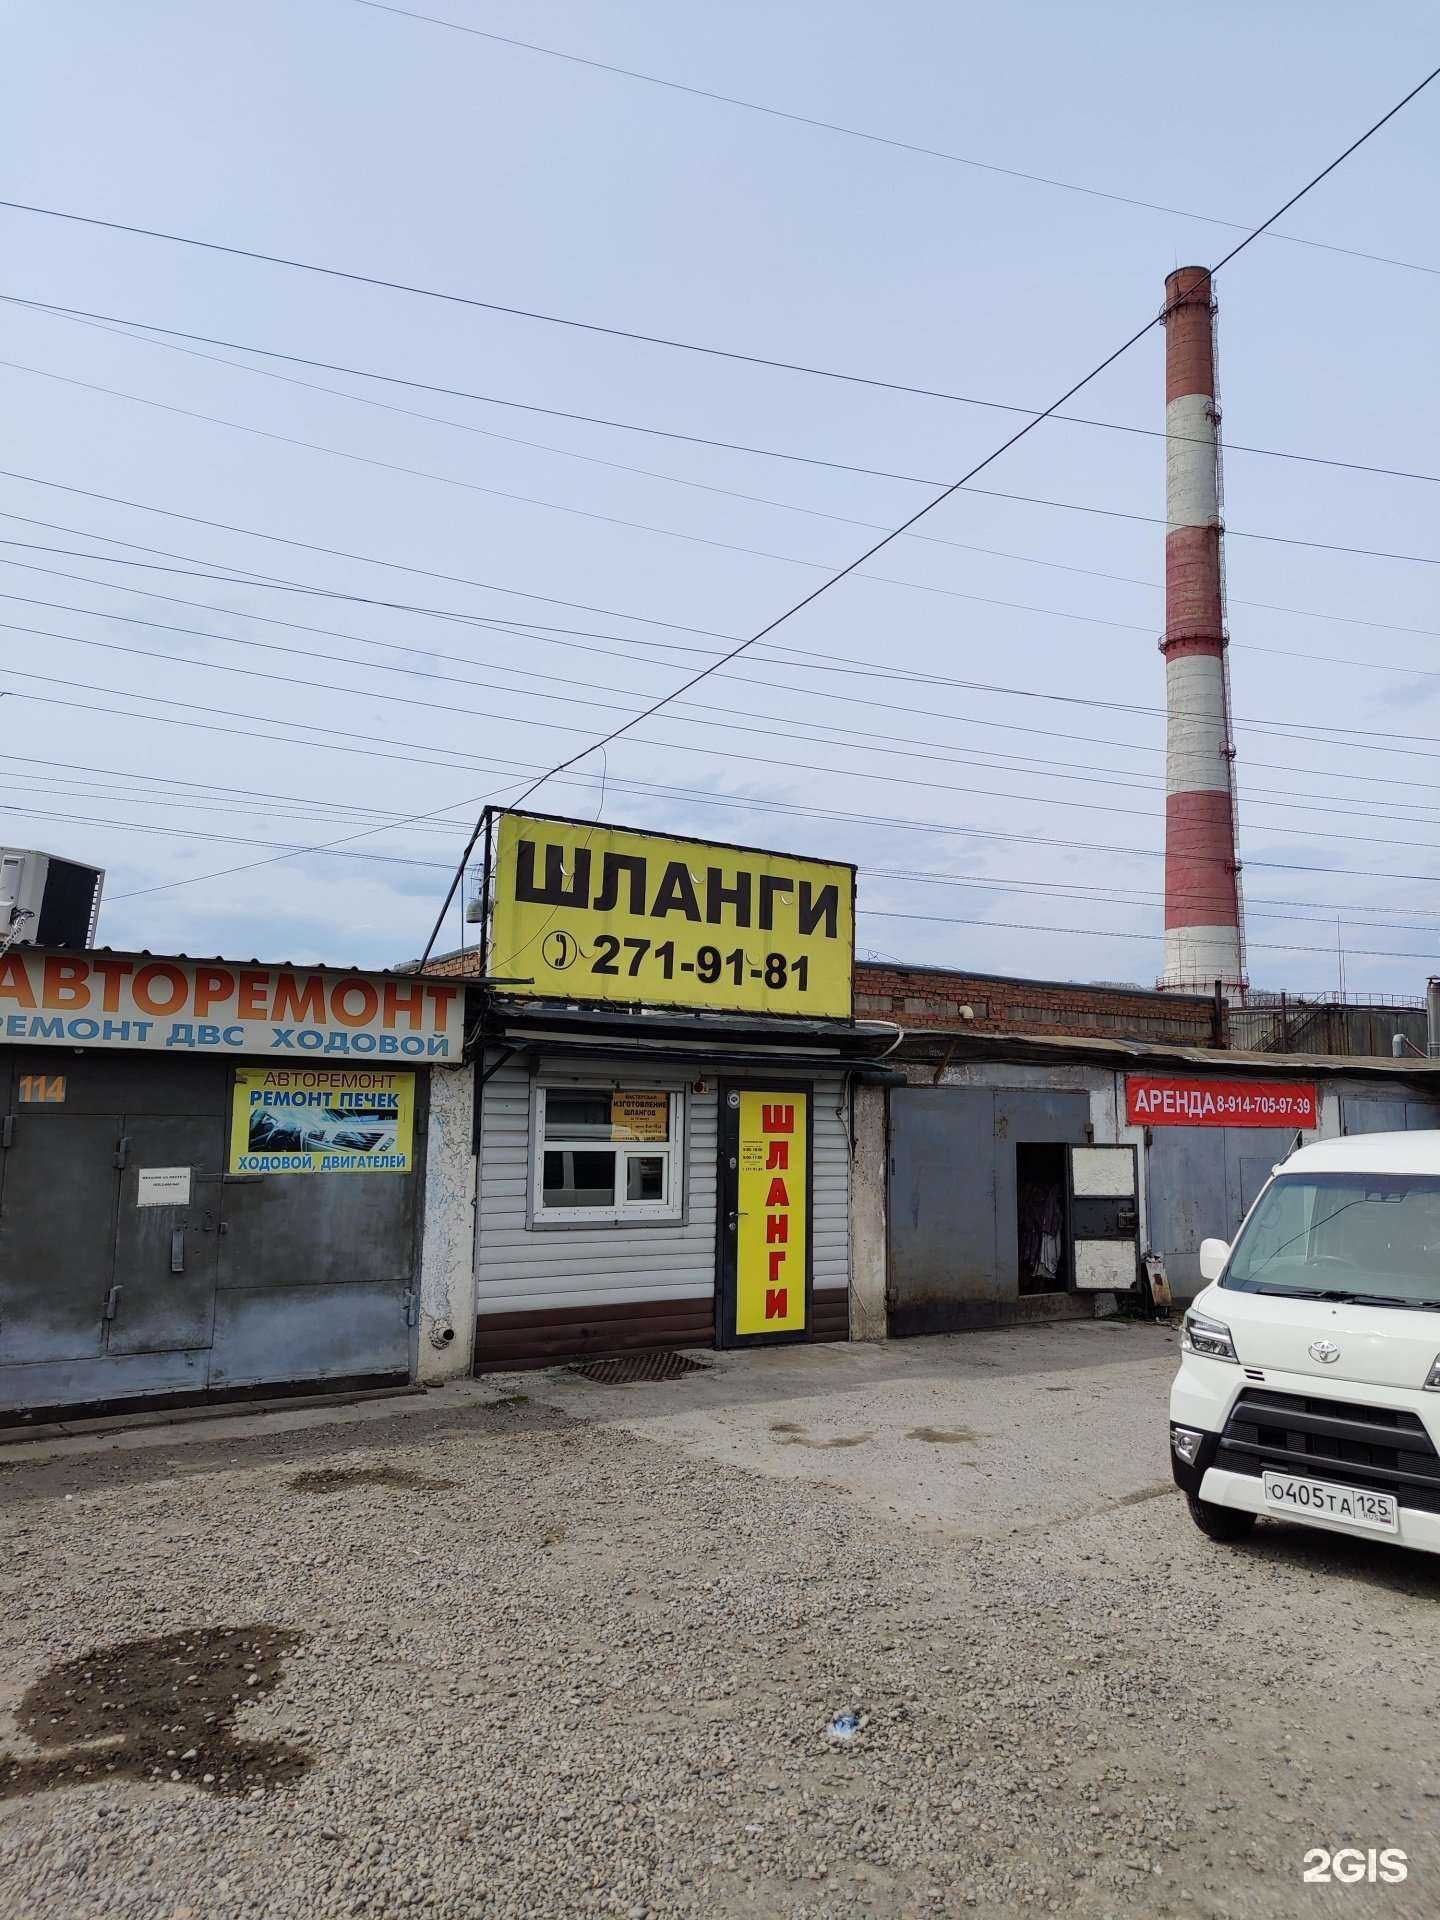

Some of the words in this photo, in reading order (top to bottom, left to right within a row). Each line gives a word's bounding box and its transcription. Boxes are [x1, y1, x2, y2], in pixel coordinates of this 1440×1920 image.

[515, 840, 839, 938] ШЛАНГИ
[591, 934, 808, 991] 271-91-81
[0, 953, 457, 1032] АВТОРЕМОНТ
[0, 1015, 154, 1041] ЕМОНТ
[166, 1024, 244, 1047] ДВС
[270, 1028, 449, 1056] ХОДОВОЙ
[20, 1076, 65, 1102] 114
[264, 1072, 397, 1088] АВТОРЕМОНТ
[250, 1091, 333, 1106] РЕМОНТ
[339, 1093, 400, 1107] ПЕЧЕК
[1135, 1089, 1216, 1118] АРЕНДА
[1217, 1096, 1311, 1114] 8-914-705-97-39
[238, 1154, 316, 1171] ХОДОВОЙ,
[320, 1153, 406, 1170] ДВИГАТЕЛЕЙ
[762, 1104, 794, 1319] ШЛАНГИ
[1357, 1495, 1389, 1516] 125
